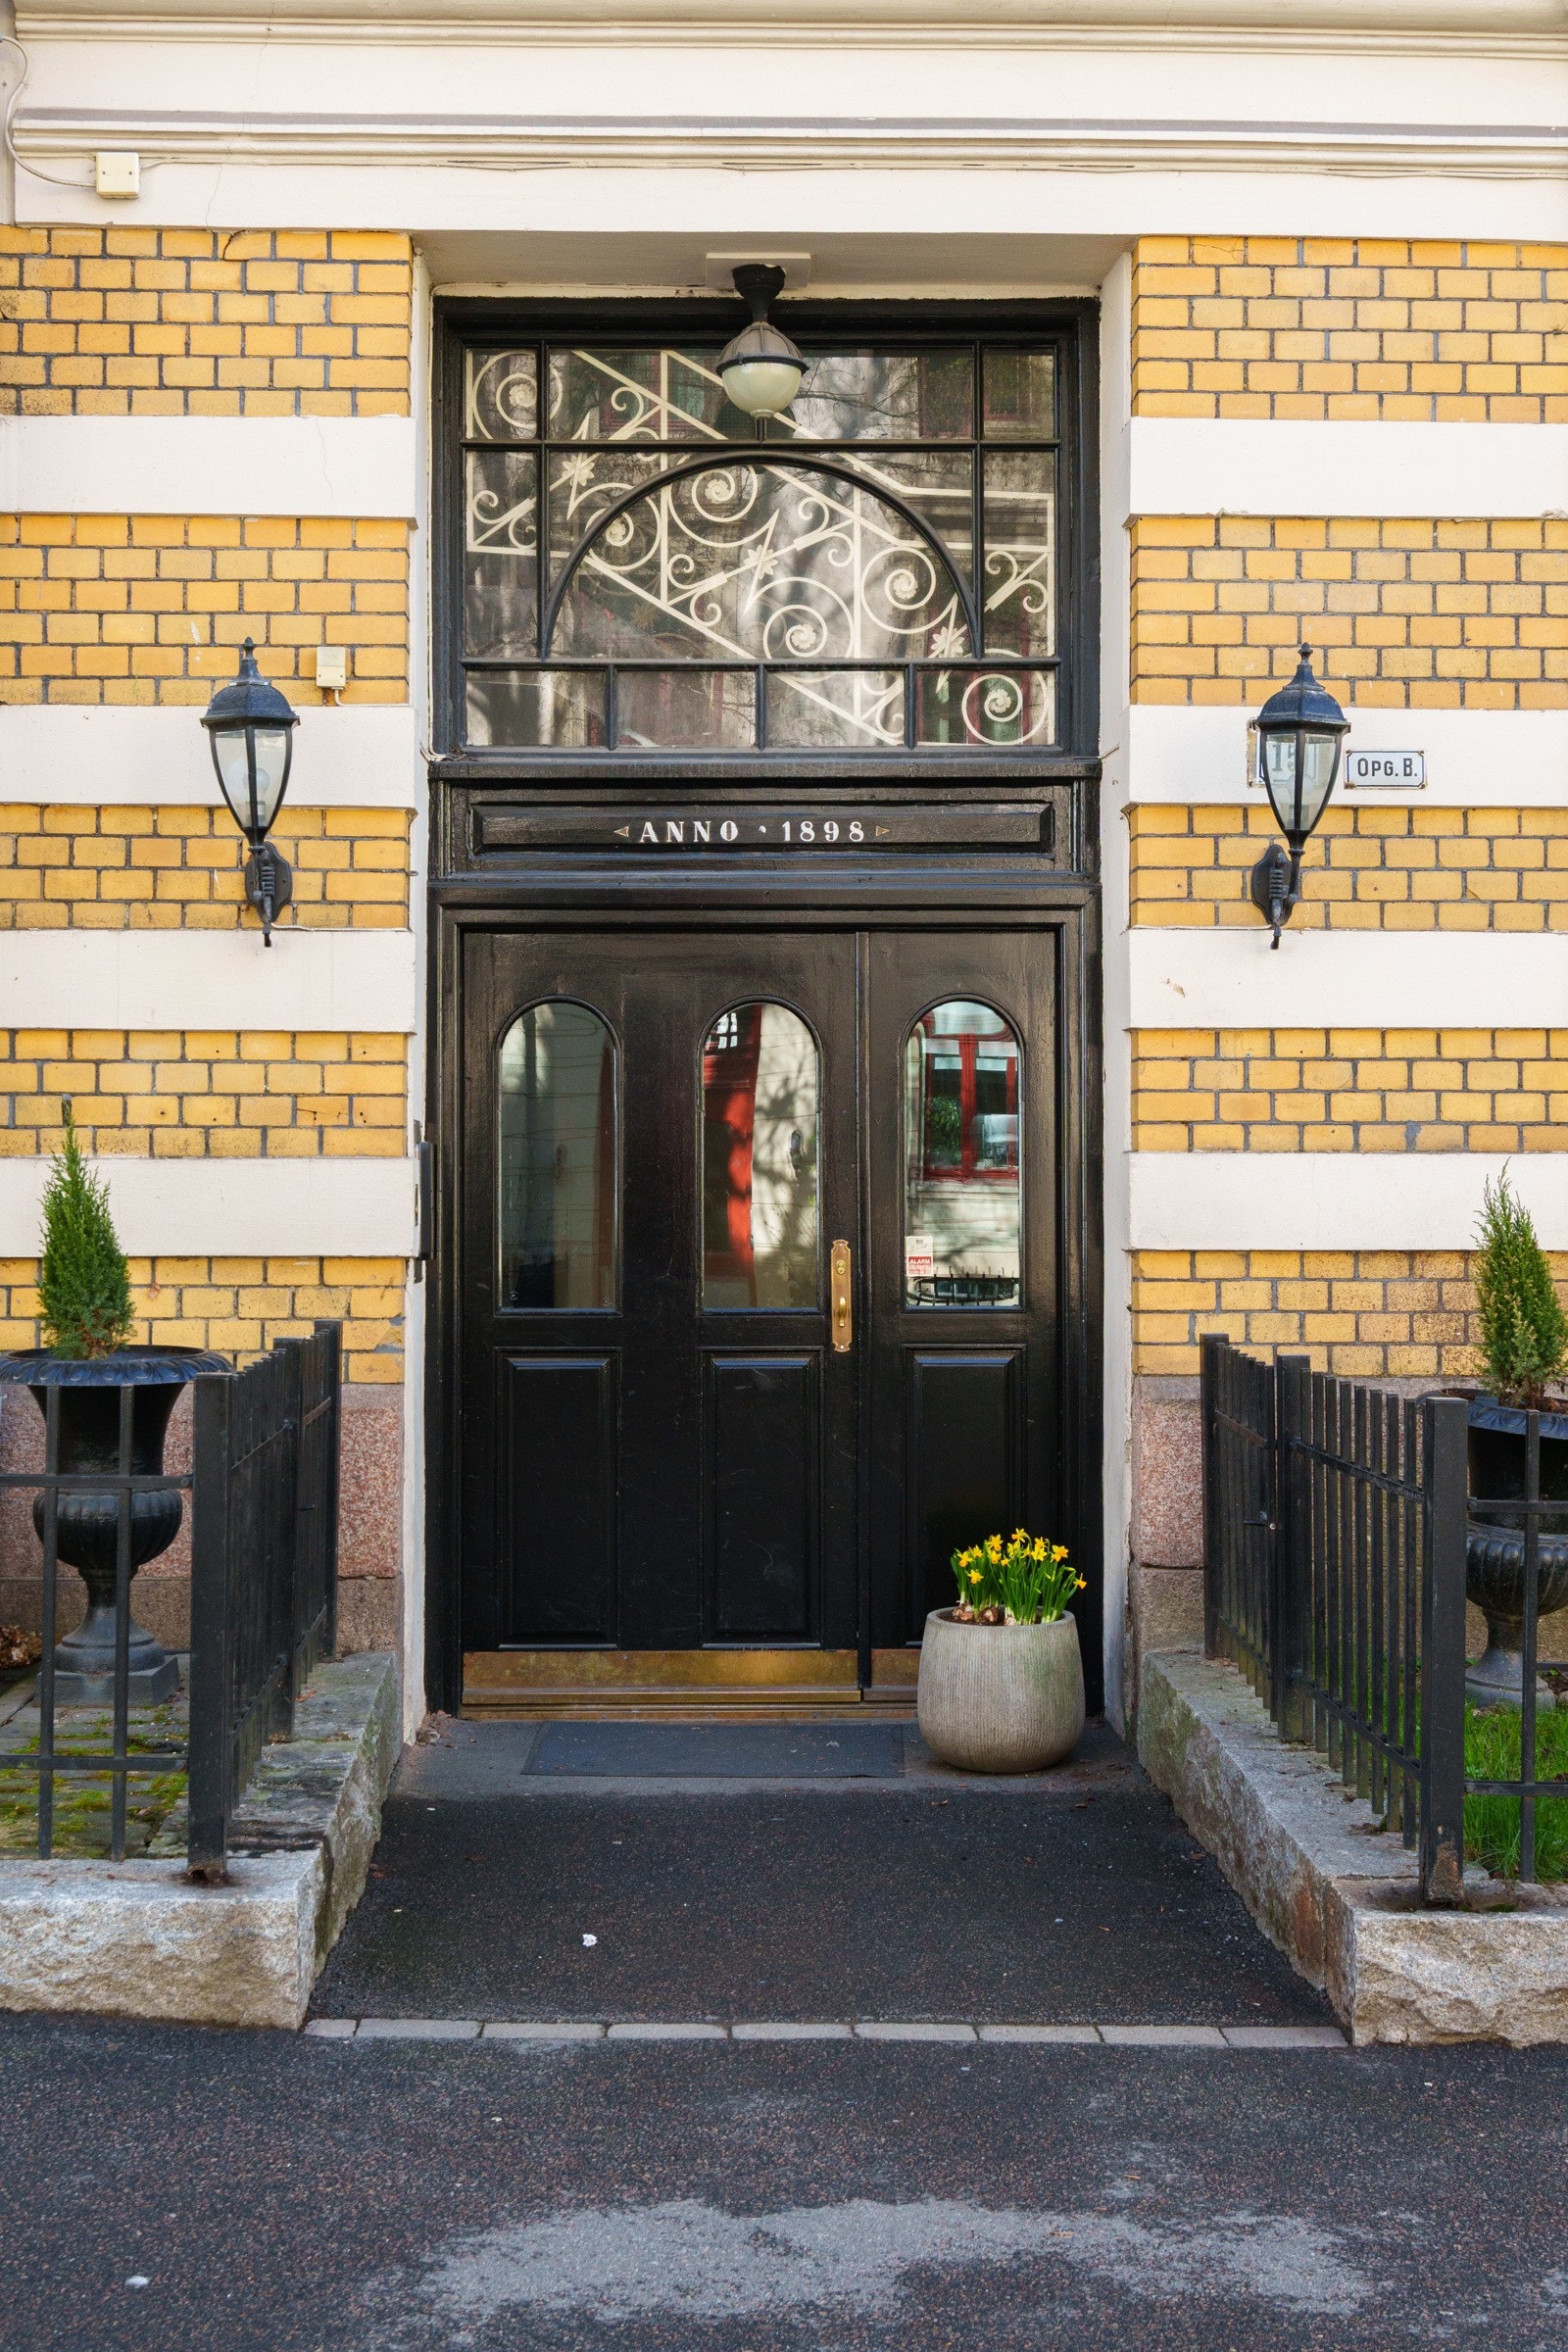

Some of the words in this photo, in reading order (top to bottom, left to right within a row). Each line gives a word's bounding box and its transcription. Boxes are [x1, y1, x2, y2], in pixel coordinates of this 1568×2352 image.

[1402, 758, 1418, 777] B.
[639, 820, 739, 843] ANNO
[782, 820, 864, 843] 1898
